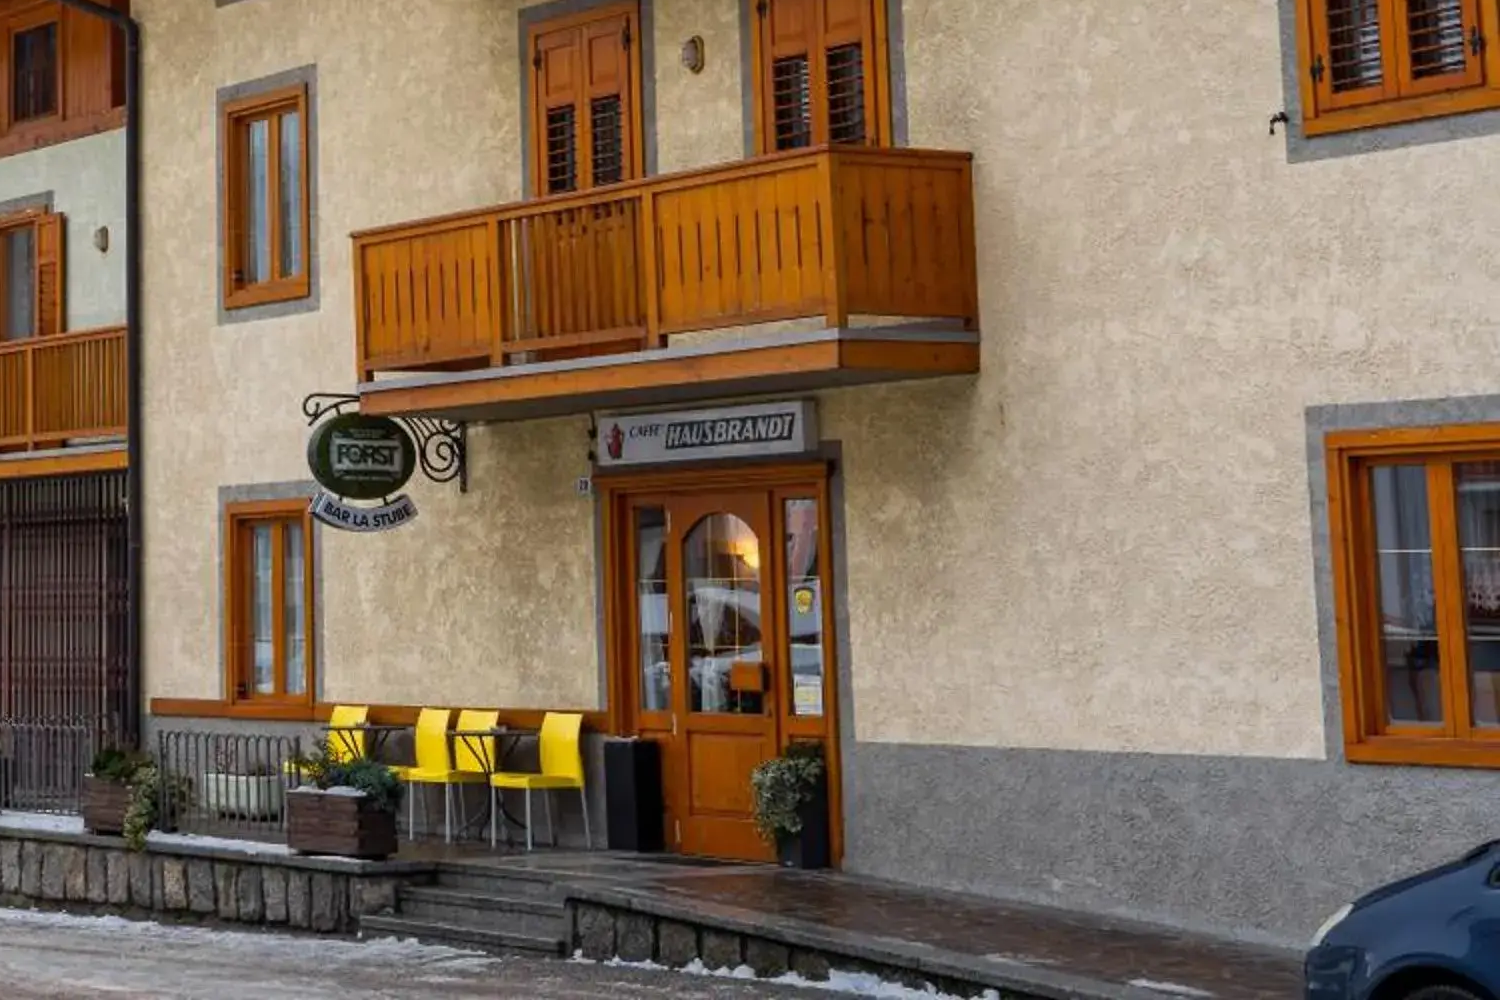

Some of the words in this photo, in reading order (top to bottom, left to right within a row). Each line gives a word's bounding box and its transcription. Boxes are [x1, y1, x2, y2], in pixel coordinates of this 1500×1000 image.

[667, 414, 793, 447] HAUSBRANDT
[337, 444, 398, 466] FORST
[324, 501, 351, 523] BAR
[353, 515, 369, 527] LA
